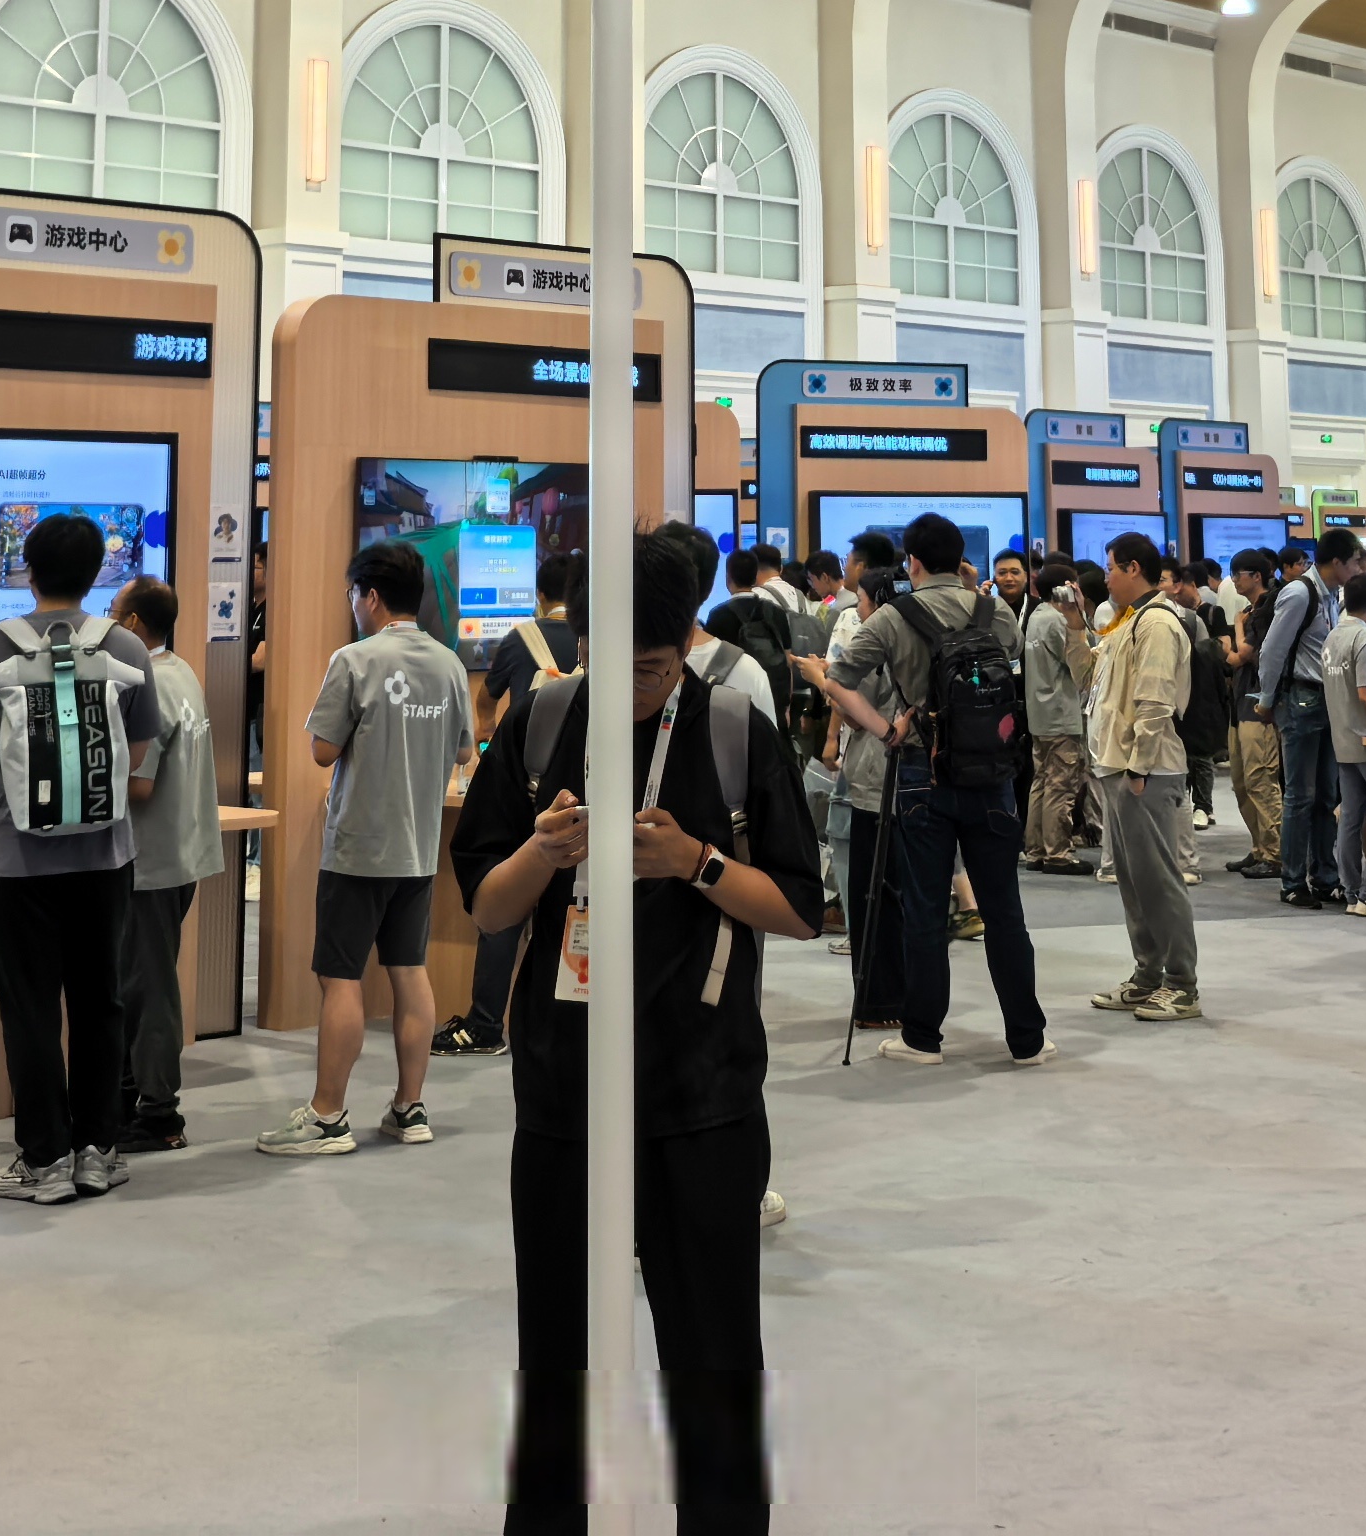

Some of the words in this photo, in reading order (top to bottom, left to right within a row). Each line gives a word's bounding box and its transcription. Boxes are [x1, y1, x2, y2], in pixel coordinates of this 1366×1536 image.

[44, 223, 129, 253] 游戏中心
[848, 376, 913, 394] 极致效率
[401, 703, 443, 719] STAFF
[82, 682, 109, 817] SEASUN
